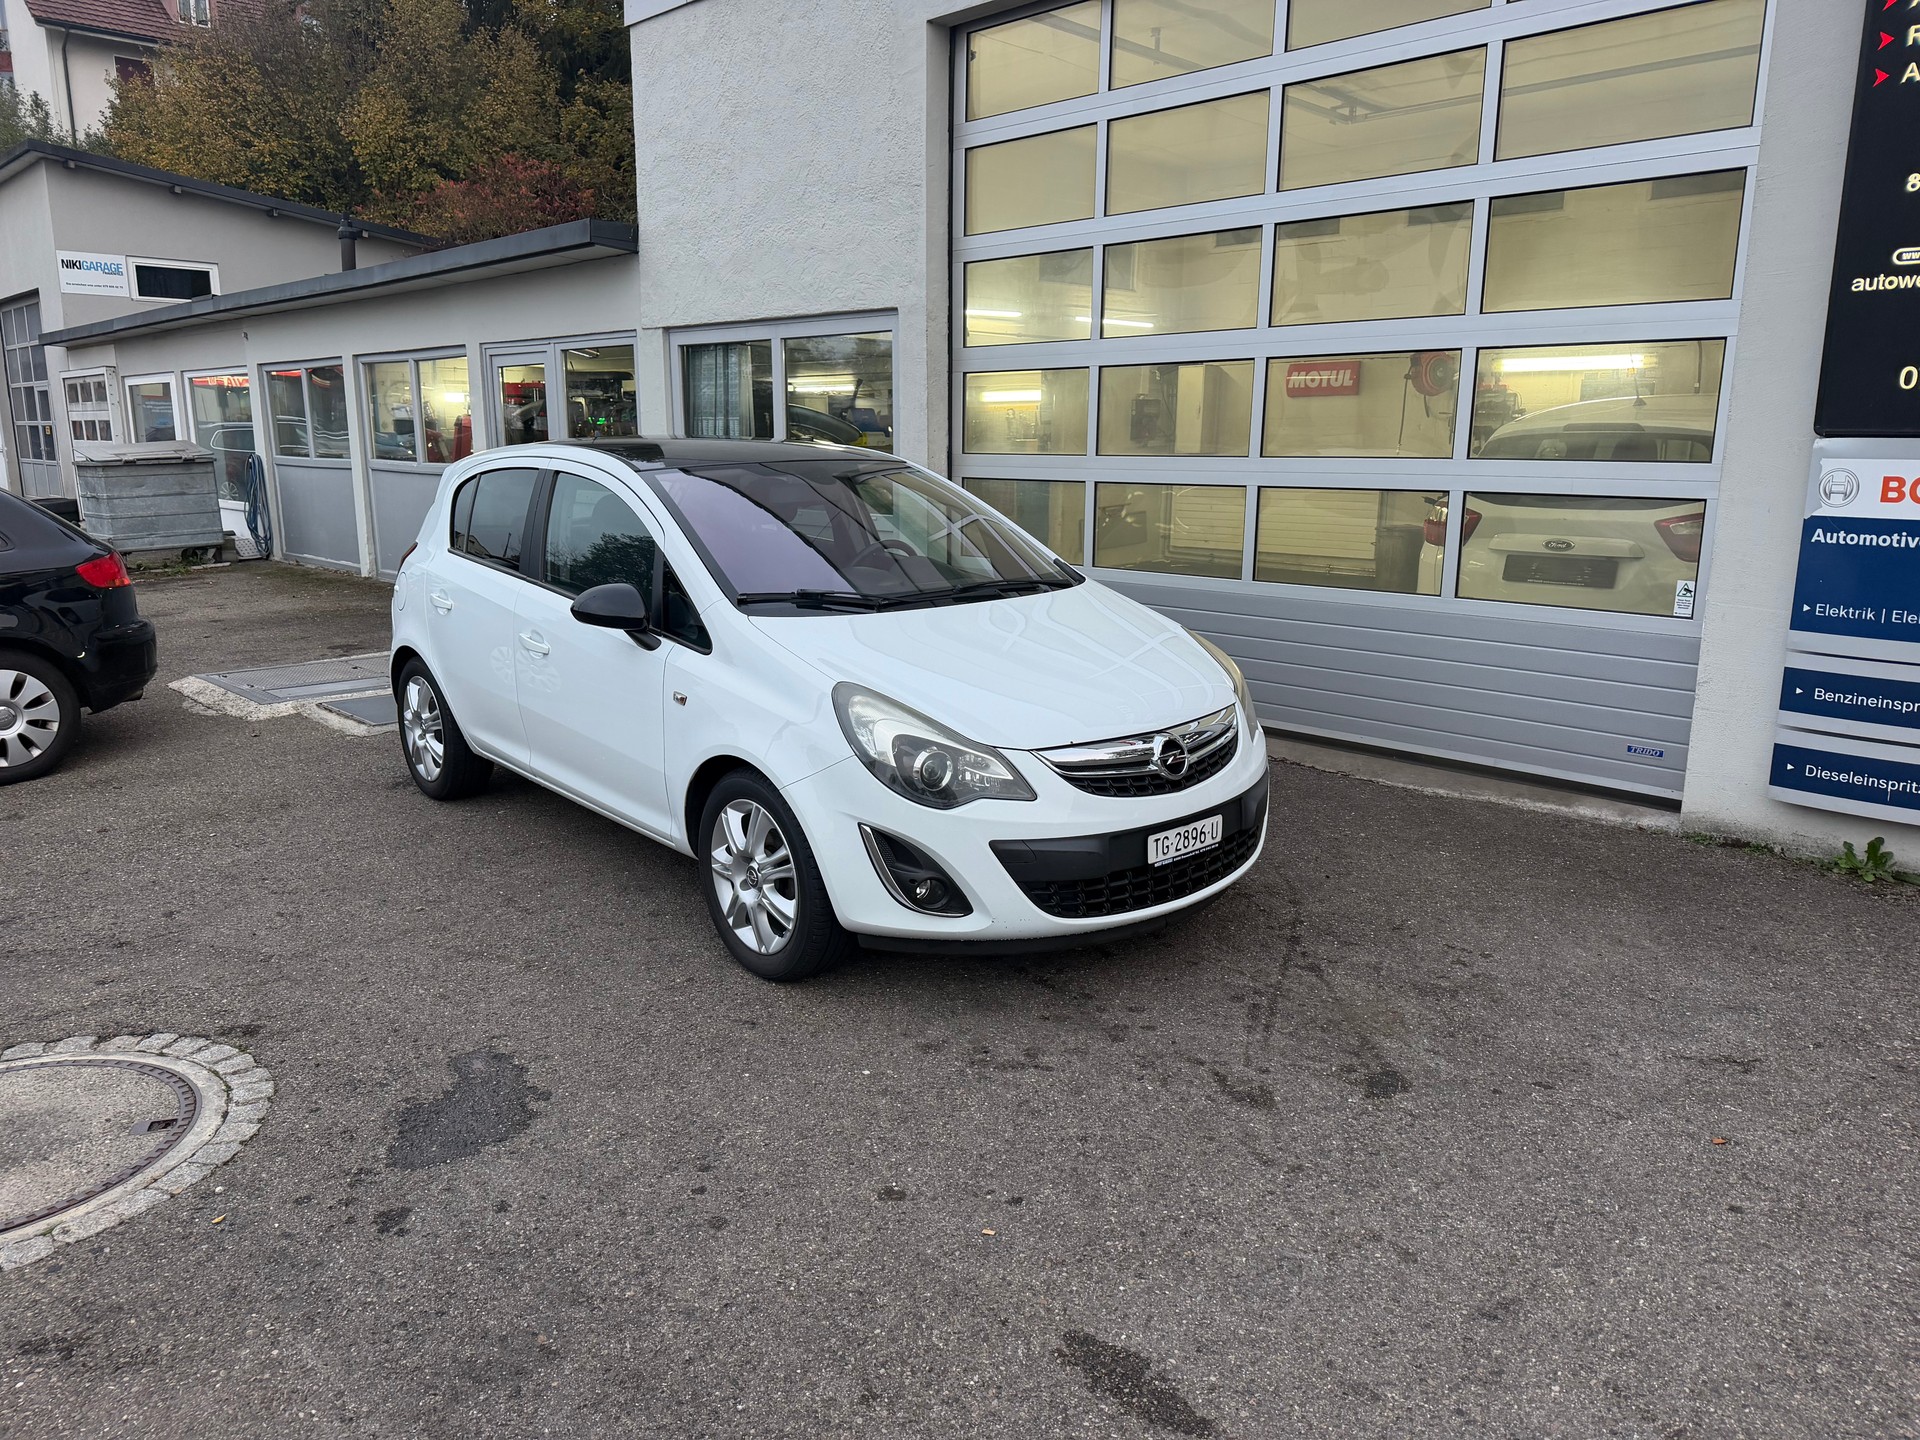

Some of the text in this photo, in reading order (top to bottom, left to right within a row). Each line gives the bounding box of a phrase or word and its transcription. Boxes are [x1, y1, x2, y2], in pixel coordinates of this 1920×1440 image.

[1288, 369, 1353, 388] MOTUL
[1900, 366, 1920, 389] 0
[1811, 528, 1920, 548] Automotiv
[1815, 604, 1875, 621] Elektrik
[1892, 610, 1920, 624] Ele
[1814, 688, 1920, 713] Benzineinspr
[1630, 746, 1660, 756] TRIDO
